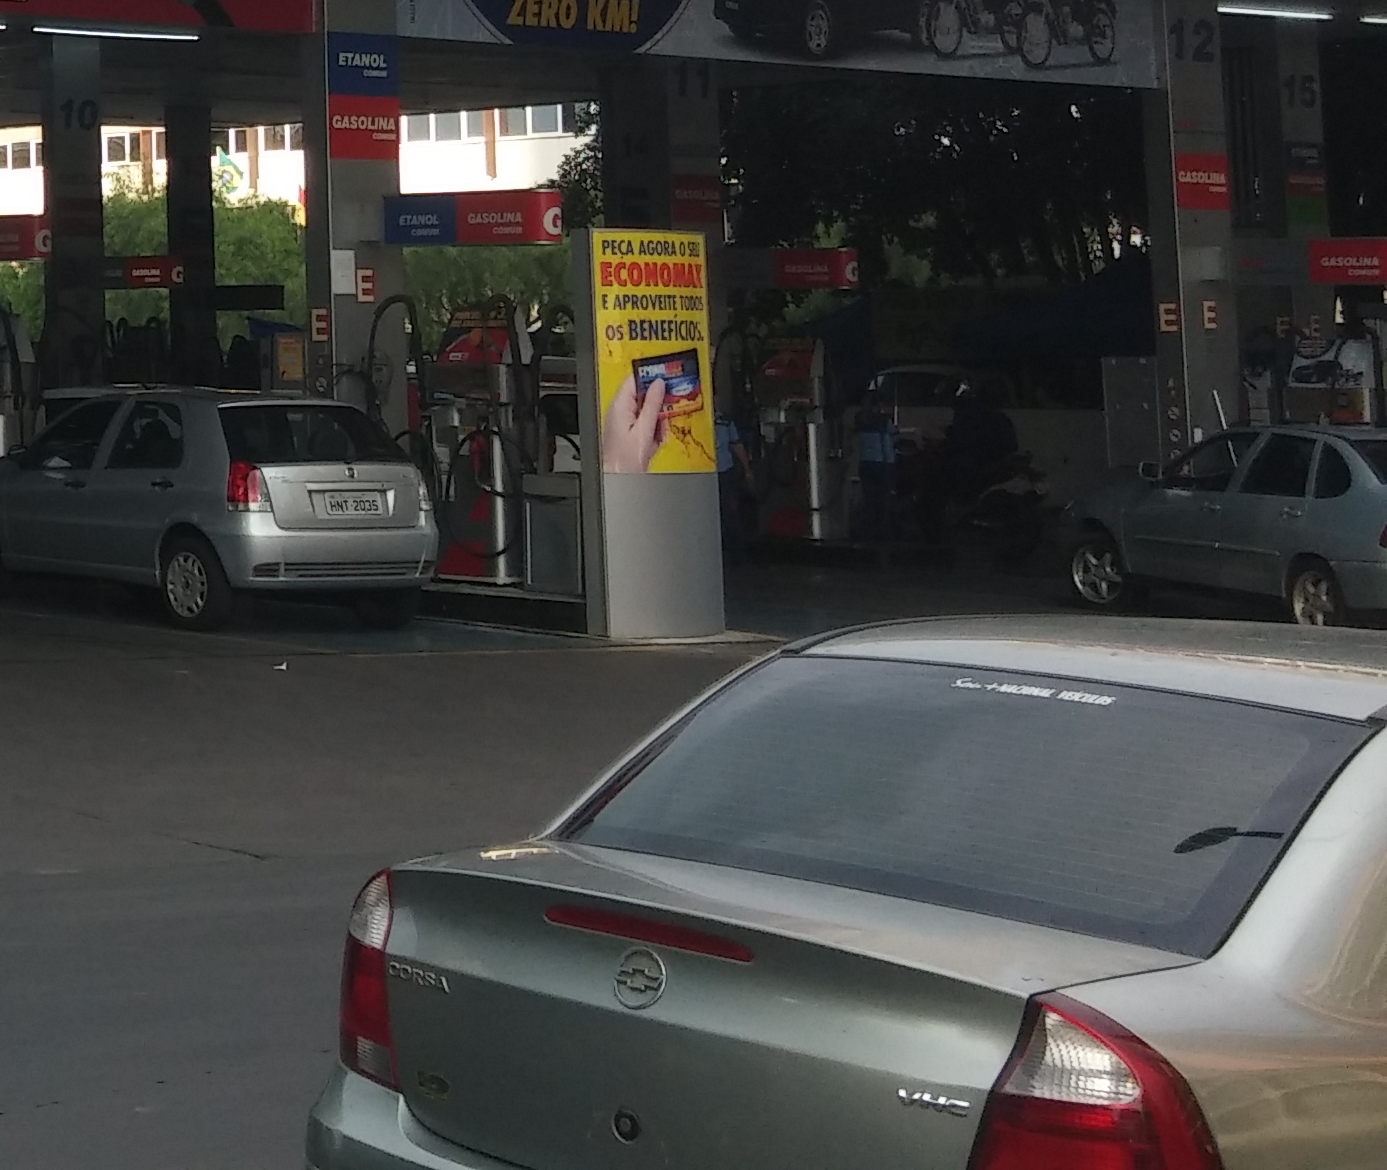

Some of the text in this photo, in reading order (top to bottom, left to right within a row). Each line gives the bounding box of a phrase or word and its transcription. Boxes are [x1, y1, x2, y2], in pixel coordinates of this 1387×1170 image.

[1168, 18, 1214, 62] 12
[338, 52, 387, 68] ETANOL
[60, 98, 98, 130] 10
[332, 114, 396, 131] GASOLINA
[1178, 170, 1227, 186] GASOLINA
[399, 212, 439, 227] ETANOL
[467, 211, 523, 226] GASOLINA
[543, 207, 562, 236] G
[34, 229, 52, 253] G
[601, 240, 700, 259] PEÇA AGORA O SEU
[1321, 255, 1380, 268] GASOLINA
[170, 266, 185, 285] G
[356, 268, 374, 302] E
[600, 261, 703, 288] ECONOMAX
[602, 294, 704, 312] E APROVEITE TODOS
[1202, 300, 1218, 330] E
[628, 314, 704, 342] BENEFÍCIOS.
[329, 499, 379, 513] HNT-2035
[388, 960, 450, 994] CORSA
[896, 1087, 971, 1116] VHC
